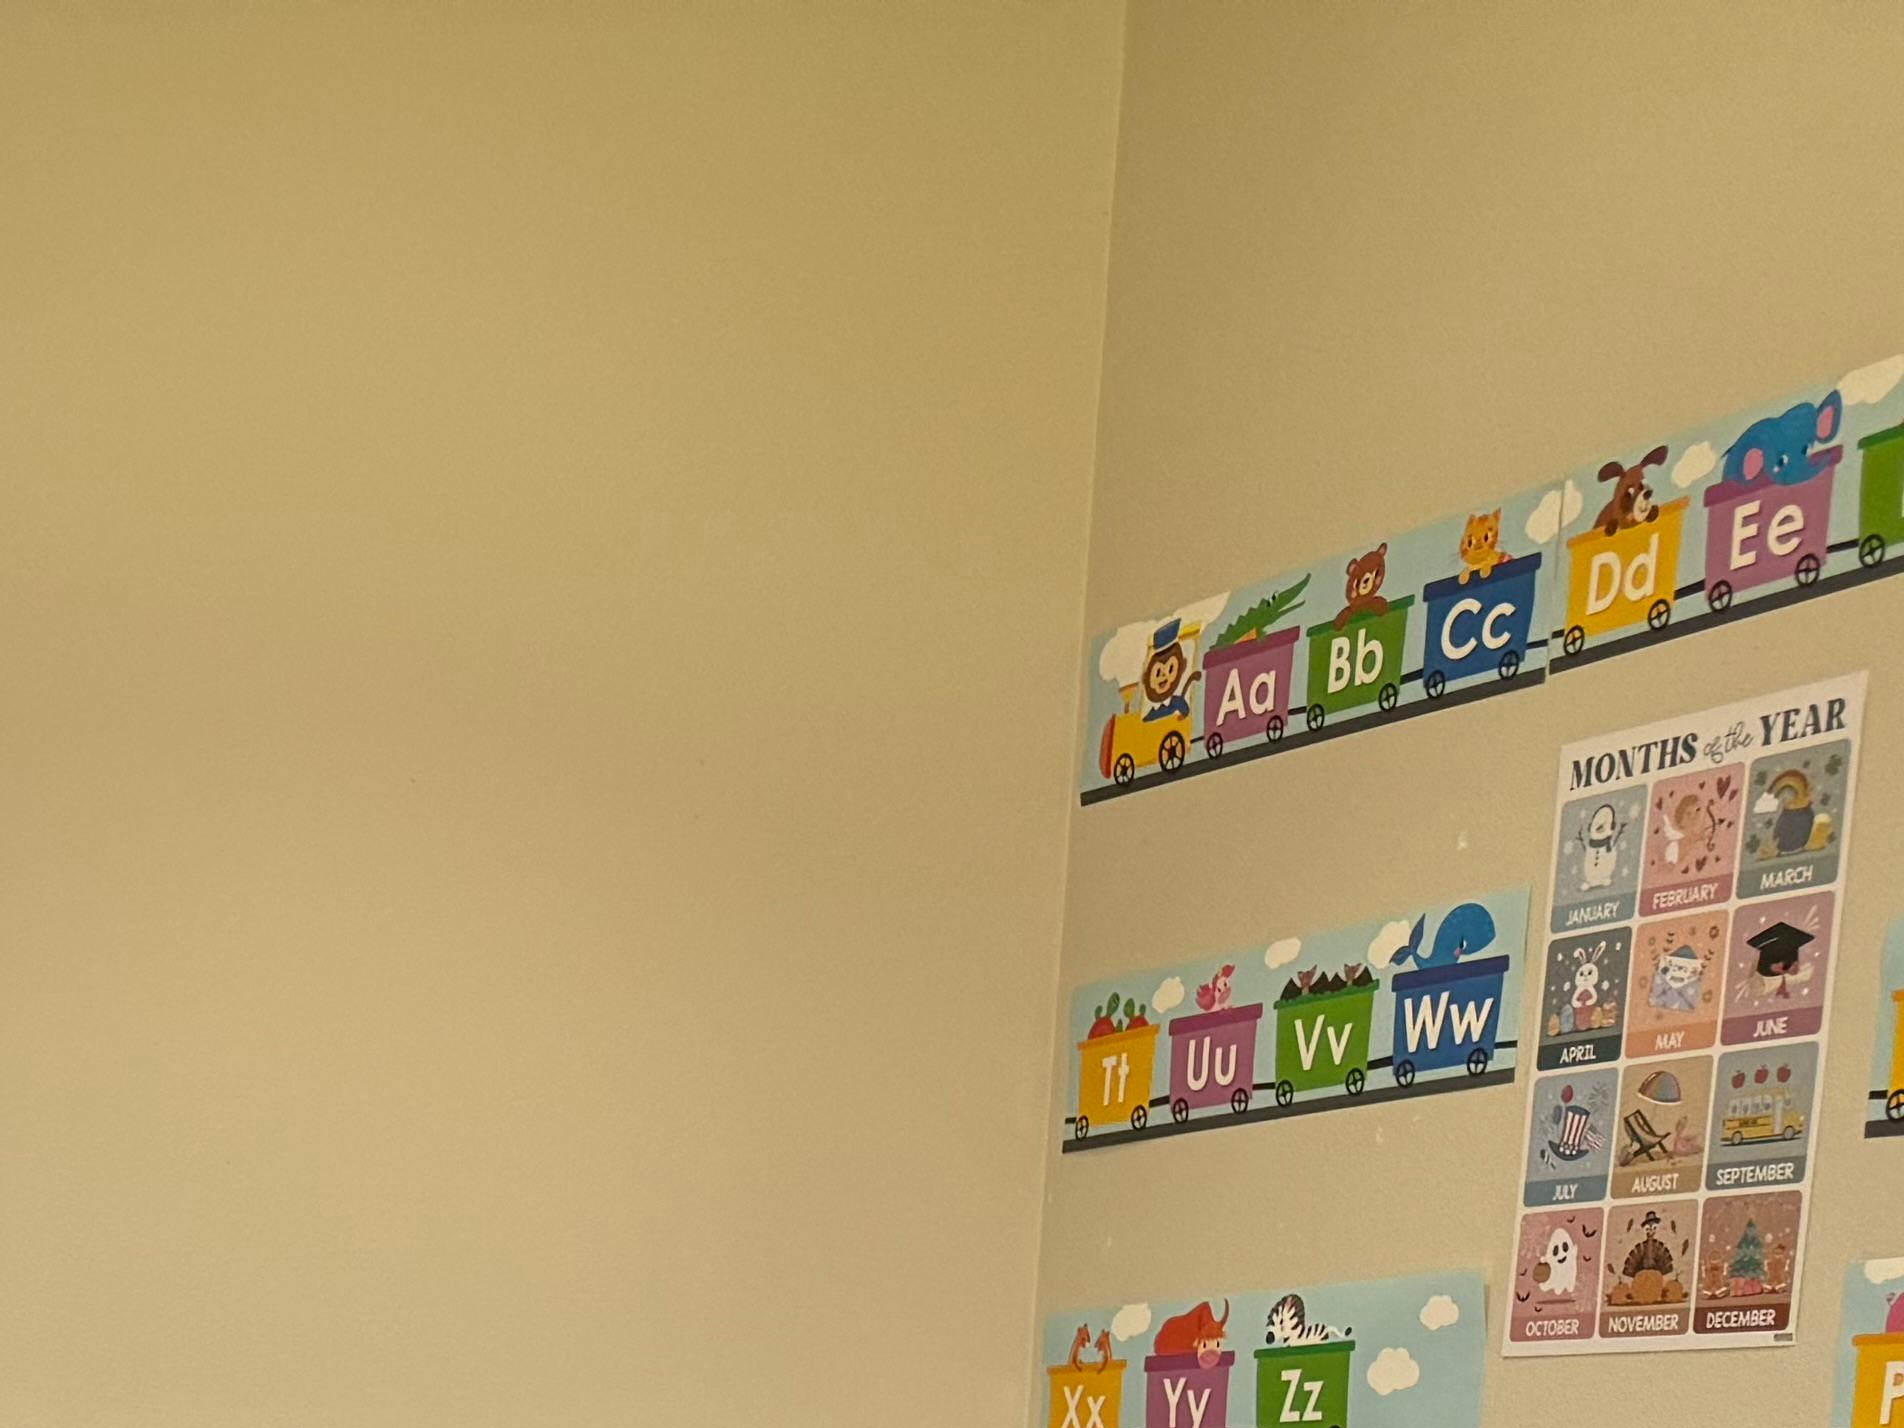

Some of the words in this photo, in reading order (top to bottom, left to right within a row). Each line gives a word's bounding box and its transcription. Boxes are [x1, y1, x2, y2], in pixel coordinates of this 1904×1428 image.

[1728, 498, 1806, 570] Ee
[1587, 541, 1661, 616] Dd
[1441, 598, 1513, 661] Cc
[1328, 628, 1384, 693] Bb
[1217, 666, 1276, 724] Aa
[1570, 733, 1698, 791] MONTHS
[1703, 742, 1722, 764] of
[1722, 721, 1754, 750] the
[1759, 698, 1847, 746] YEAR
[1760, 866, 1814, 889] MARCH
[1653, 883, 1719, 909] FEBRUARY
[1565, 902, 1619, 926] JANUARY
[1404, 991, 1494, 1053] Ww
[1753, 1017, 1788, 1037] JUNE
[1294, 1015, 1353, 1071] Vv
[1655, 1032, 1684, 1049] MAY
[1186, 1037, 1236, 1090] Uu
[1559, 1045, 1596, 1063] APRIL
[1102, 1056, 1129, 1106] Tt
[1632, 1174, 1678, 1193] AUGUST
[1716, 1163, 1794, 1185] SEPTEMBER
[1553, 1184, 1577, 1200] JULY
[1526, 1319, 1579, 1336] OCTOBER
[1608, 1315, 1679, 1332] NOVEMBER
[1706, 1309, 1775, 1328] DECEMBER
[1279, 1368, 1324, 1423] Zz
